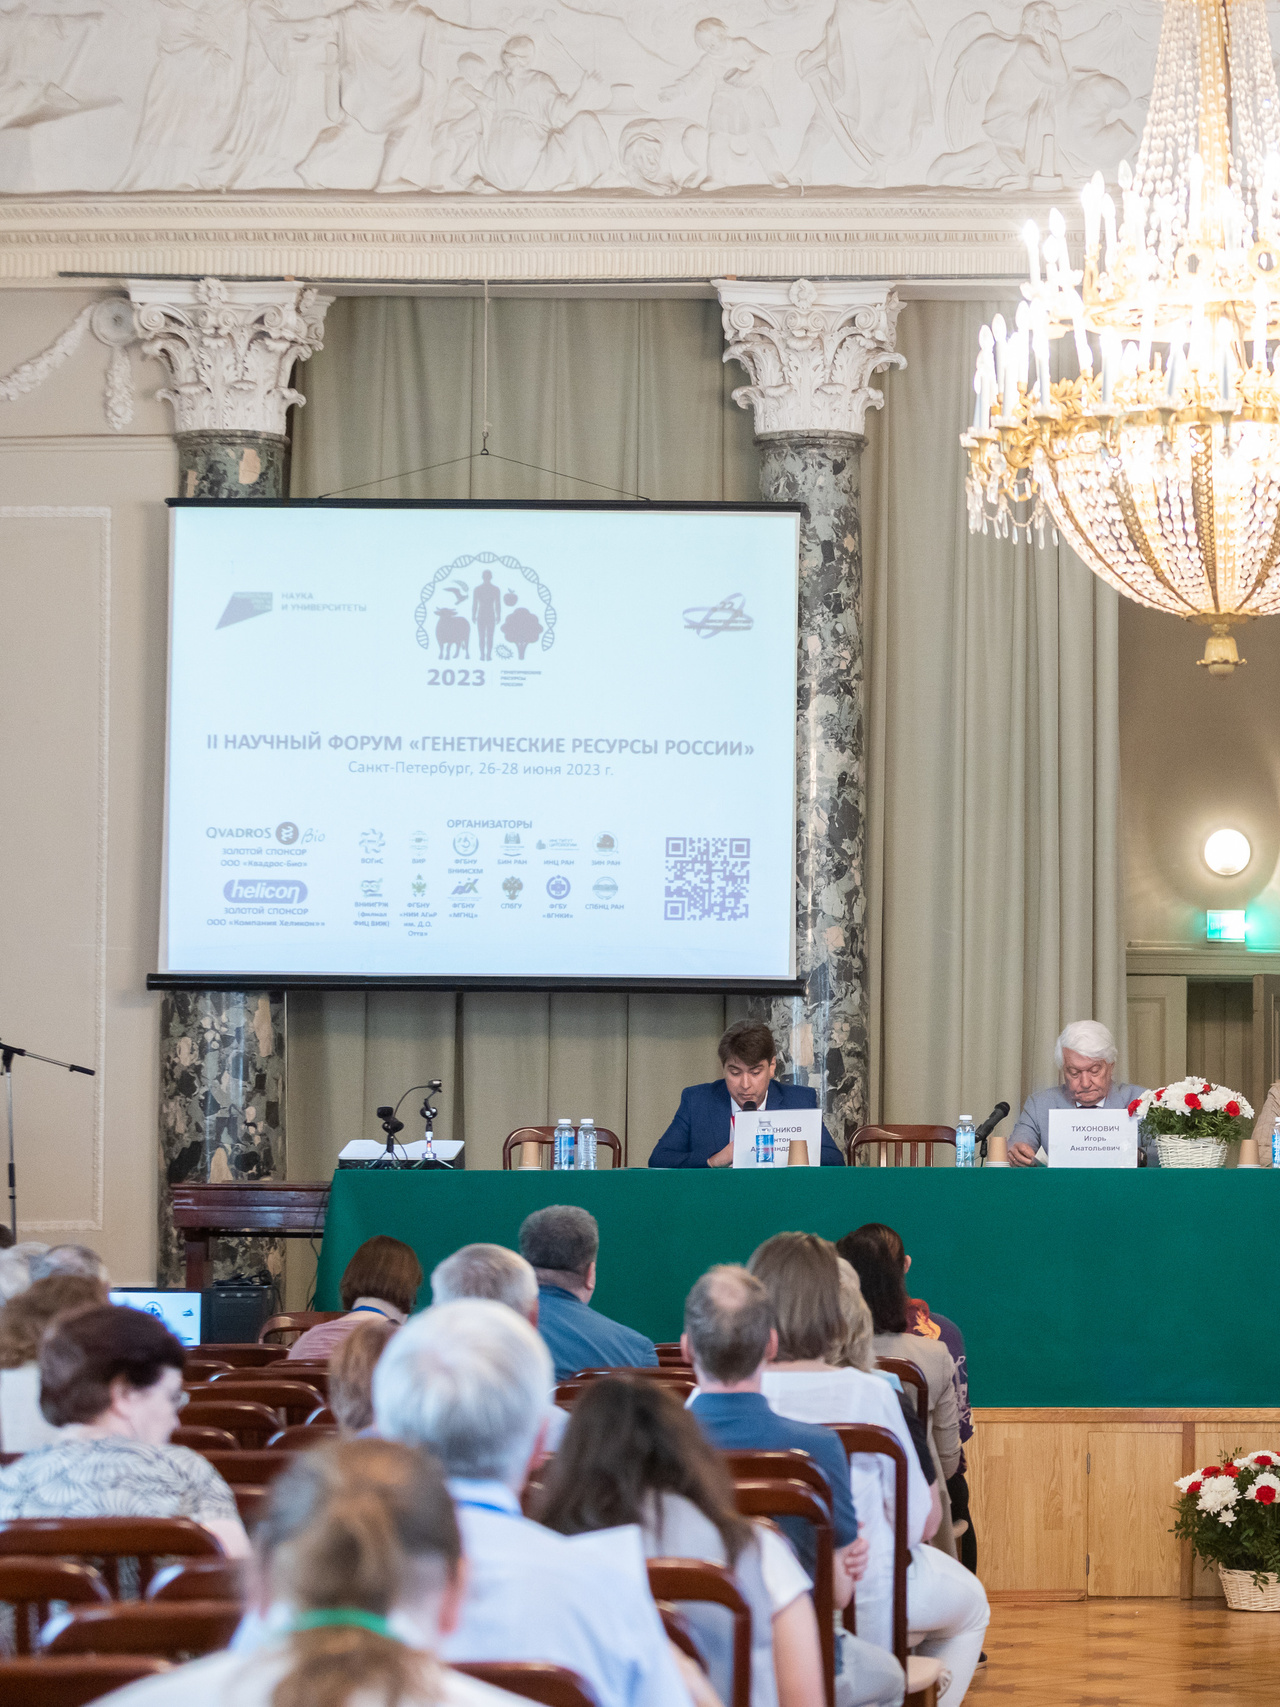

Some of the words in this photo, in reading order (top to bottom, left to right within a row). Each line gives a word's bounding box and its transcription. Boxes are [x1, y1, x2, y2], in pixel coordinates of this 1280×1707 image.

[281, 592, 314, 600] НАУКА
[291, 604, 367, 612] УНИВЕРСИТЕТЫ
[426, 669, 486, 687] 2023
[224, 731, 321, 750] НАУЧНЫЙ
[328, 735, 402, 751] ФОРУМ
[409, 736, 565, 753] «ГЕНЕТИЧЕСКИЕ
[572, 738, 658, 755] РЕСУРСЫ
[665, 739, 754, 756] РОССИИ»
[348, 761, 474, 776] Санкт-Петербург,
[479, 762, 518, 775] 26-28
[523, 764, 561, 775] июня
[566, 763, 600, 776] 2023
[606, 766, 614, 776] г.
[447, 820, 532, 829] ОРГАНИЗАТОРЫ
[206, 827, 272, 839] QVADROS
[222, 847, 263, 855] ЗОЛОТОЙ
[243, 860, 308, 868] «Квадрос-Био»
[232, 880, 300, 904] helicon
